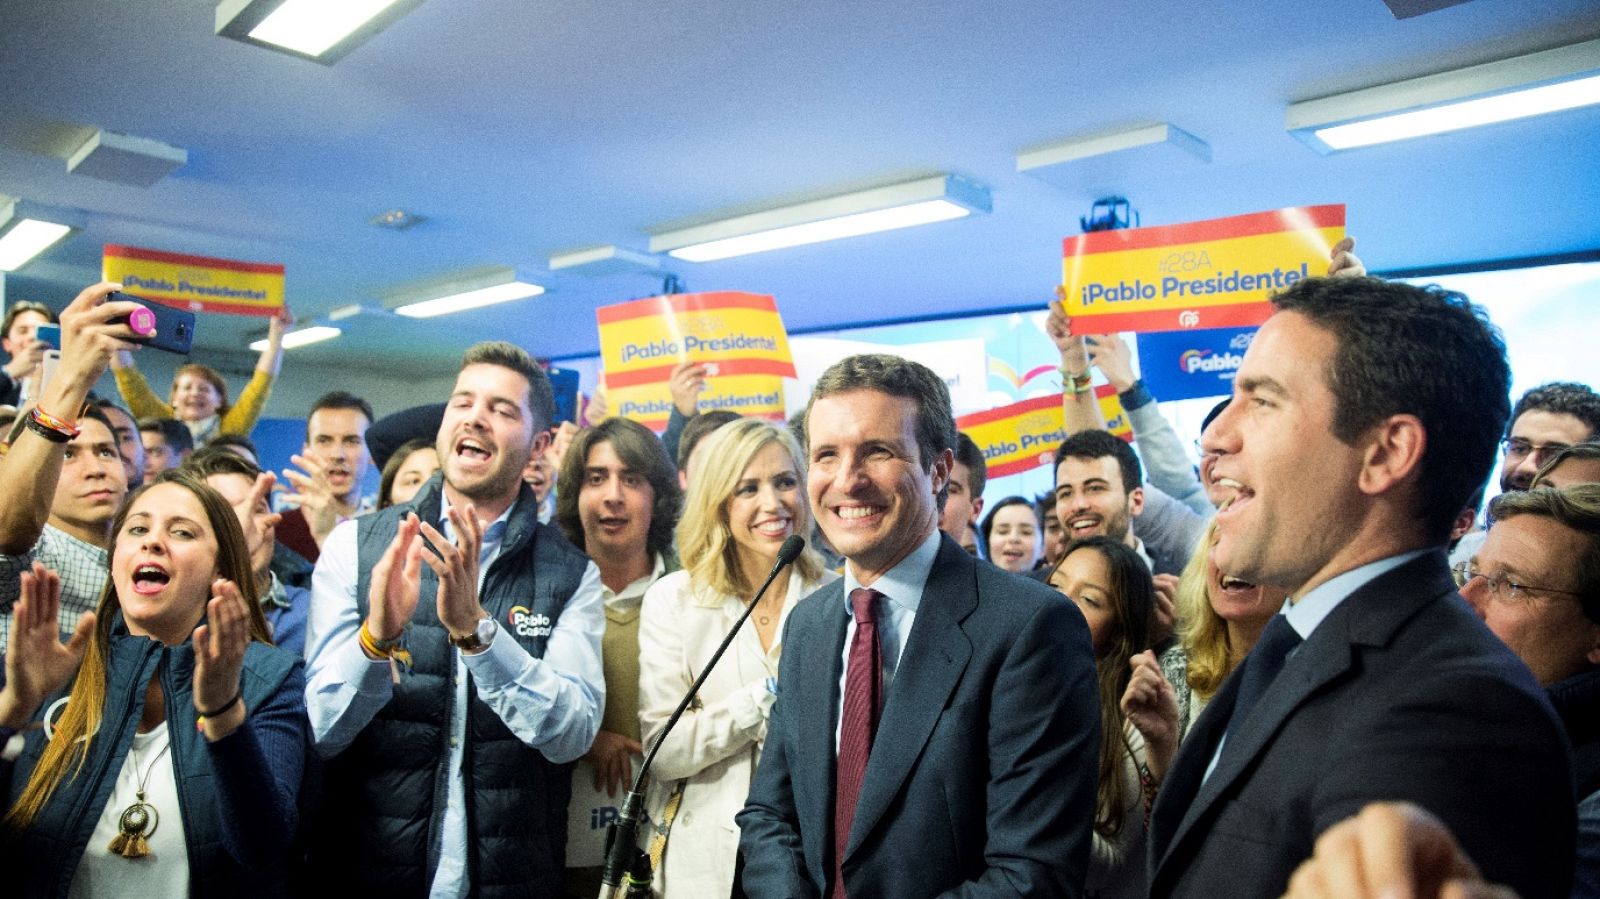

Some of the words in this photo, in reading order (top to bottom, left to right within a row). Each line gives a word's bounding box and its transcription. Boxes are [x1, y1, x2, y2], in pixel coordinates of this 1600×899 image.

[1158, 250, 1212, 274] #28A
[1082, 280, 1156, 305] ¡Pablo
[1162, 262, 1308, 298] Presidente!
[621, 338, 679, 363] ¡Pablo
[684, 334, 777, 353] Presidente!
[1187, 351, 1243, 374] Pablo
[696, 391, 779, 410] esidente!
[980, 441, 1018, 460] ablo
[514, 612, 550, 627] Pablo
